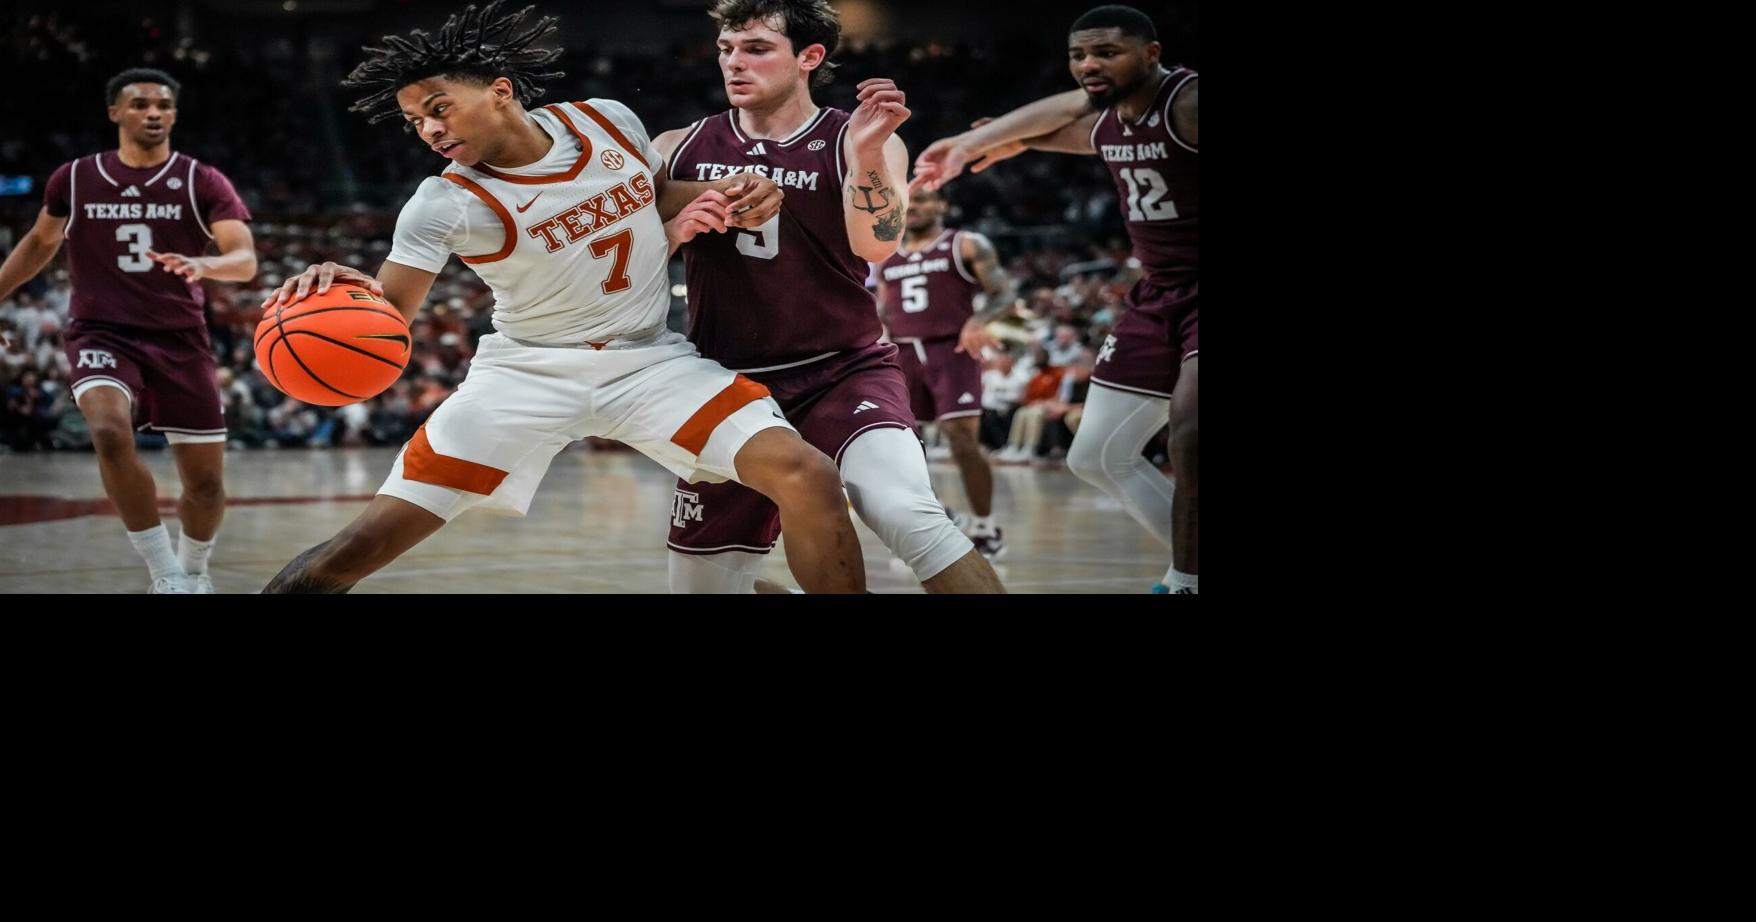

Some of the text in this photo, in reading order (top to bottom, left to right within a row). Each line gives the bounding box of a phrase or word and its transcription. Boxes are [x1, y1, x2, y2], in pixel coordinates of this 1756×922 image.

[1101, 142, 1168, 162] TEXAS A&M
[771, 167, 819, 191] A&M
[1119, 167, 1179, 222] 12
[83, 203, 183, 220] TEXAS A&M
[527, 171, 655, 254] TEXAS
[115, 223, 154, 273] 3
[587, 227, 634, 295] 7
[901, 275, 929, 313] 5
